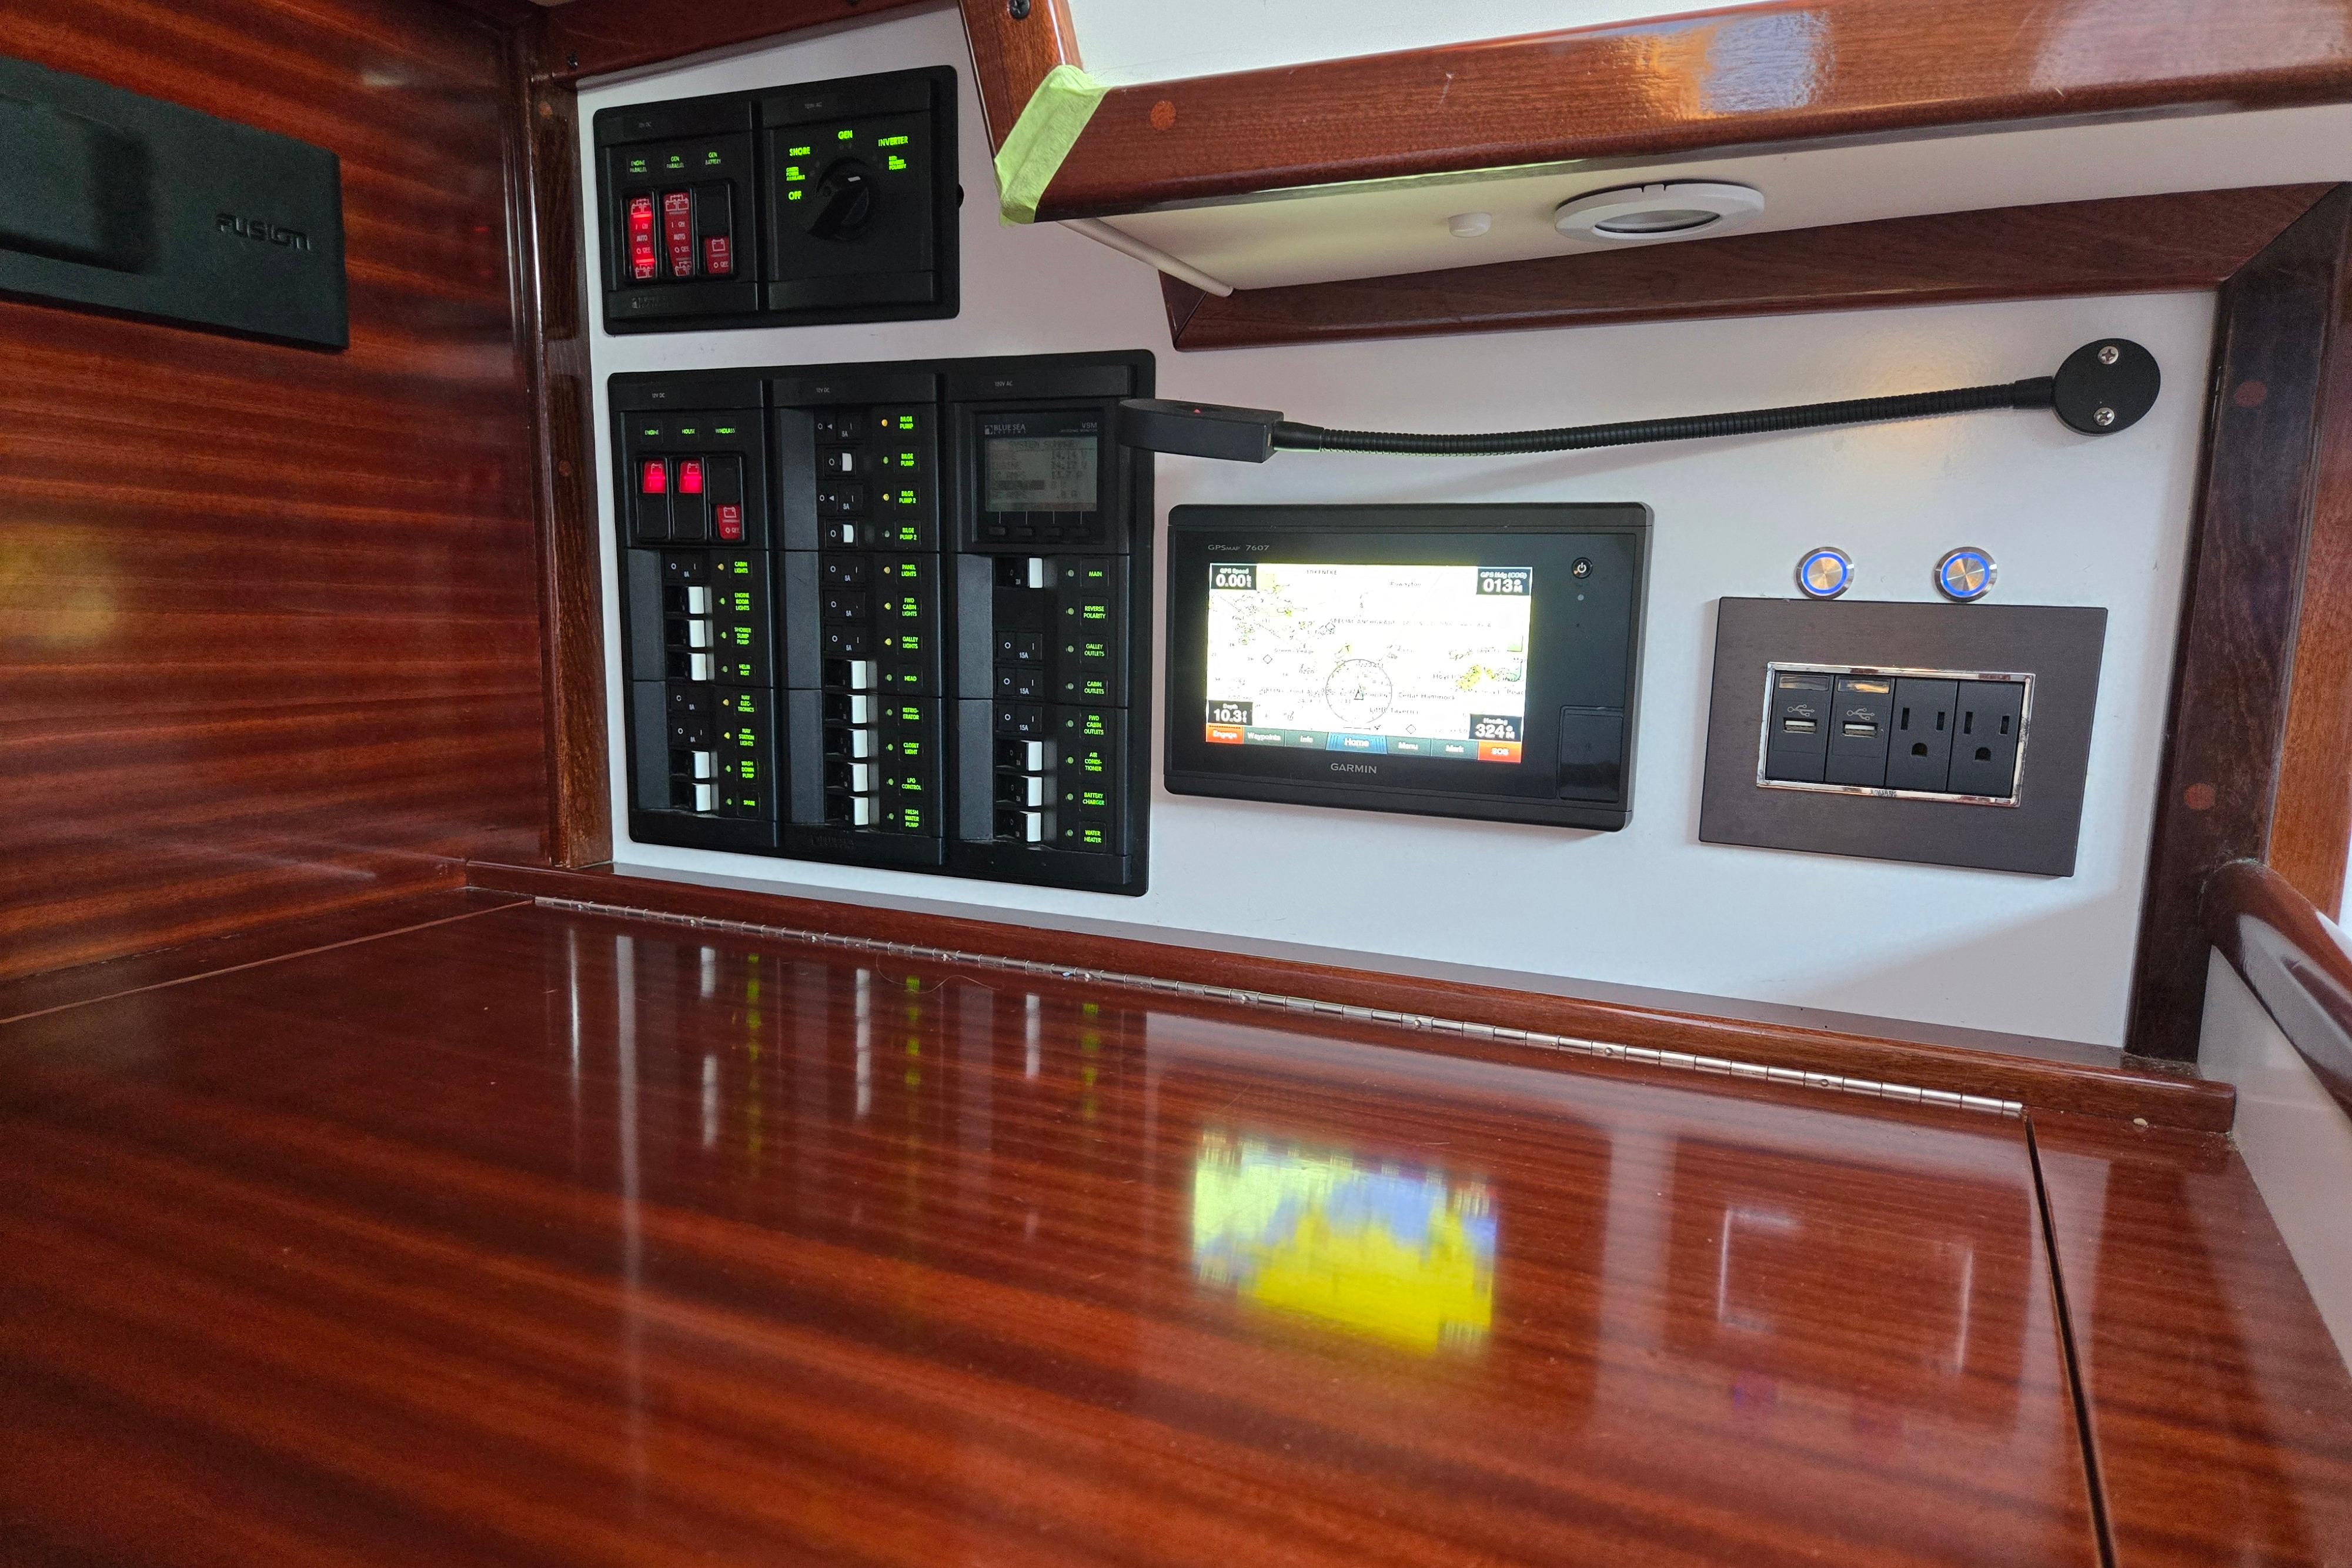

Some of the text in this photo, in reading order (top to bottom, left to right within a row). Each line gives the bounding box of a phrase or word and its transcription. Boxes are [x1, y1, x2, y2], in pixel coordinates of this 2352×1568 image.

[838, 130, 853, 139] GEN
[878, 136, 908, 146] INVERTER
[789, 146, 810, 156] SHORE
[788, 190, 801, 200] OFF
[1215, 574, 1246, 587] 0.00
[1483, 578, 1513, 593] 013
[1214, 708, 1242, 723] 10.3
[1475, 723, 1505, 738] 324
[1247, 731, 1281, 741] Waypoints
[1344, 738, 1370, 747] Home
[1398, 741, 1418, 750] Menu
[1445, 744, 1464, 753] Mark
[1330, 763, 1377, 774] GARMIN
